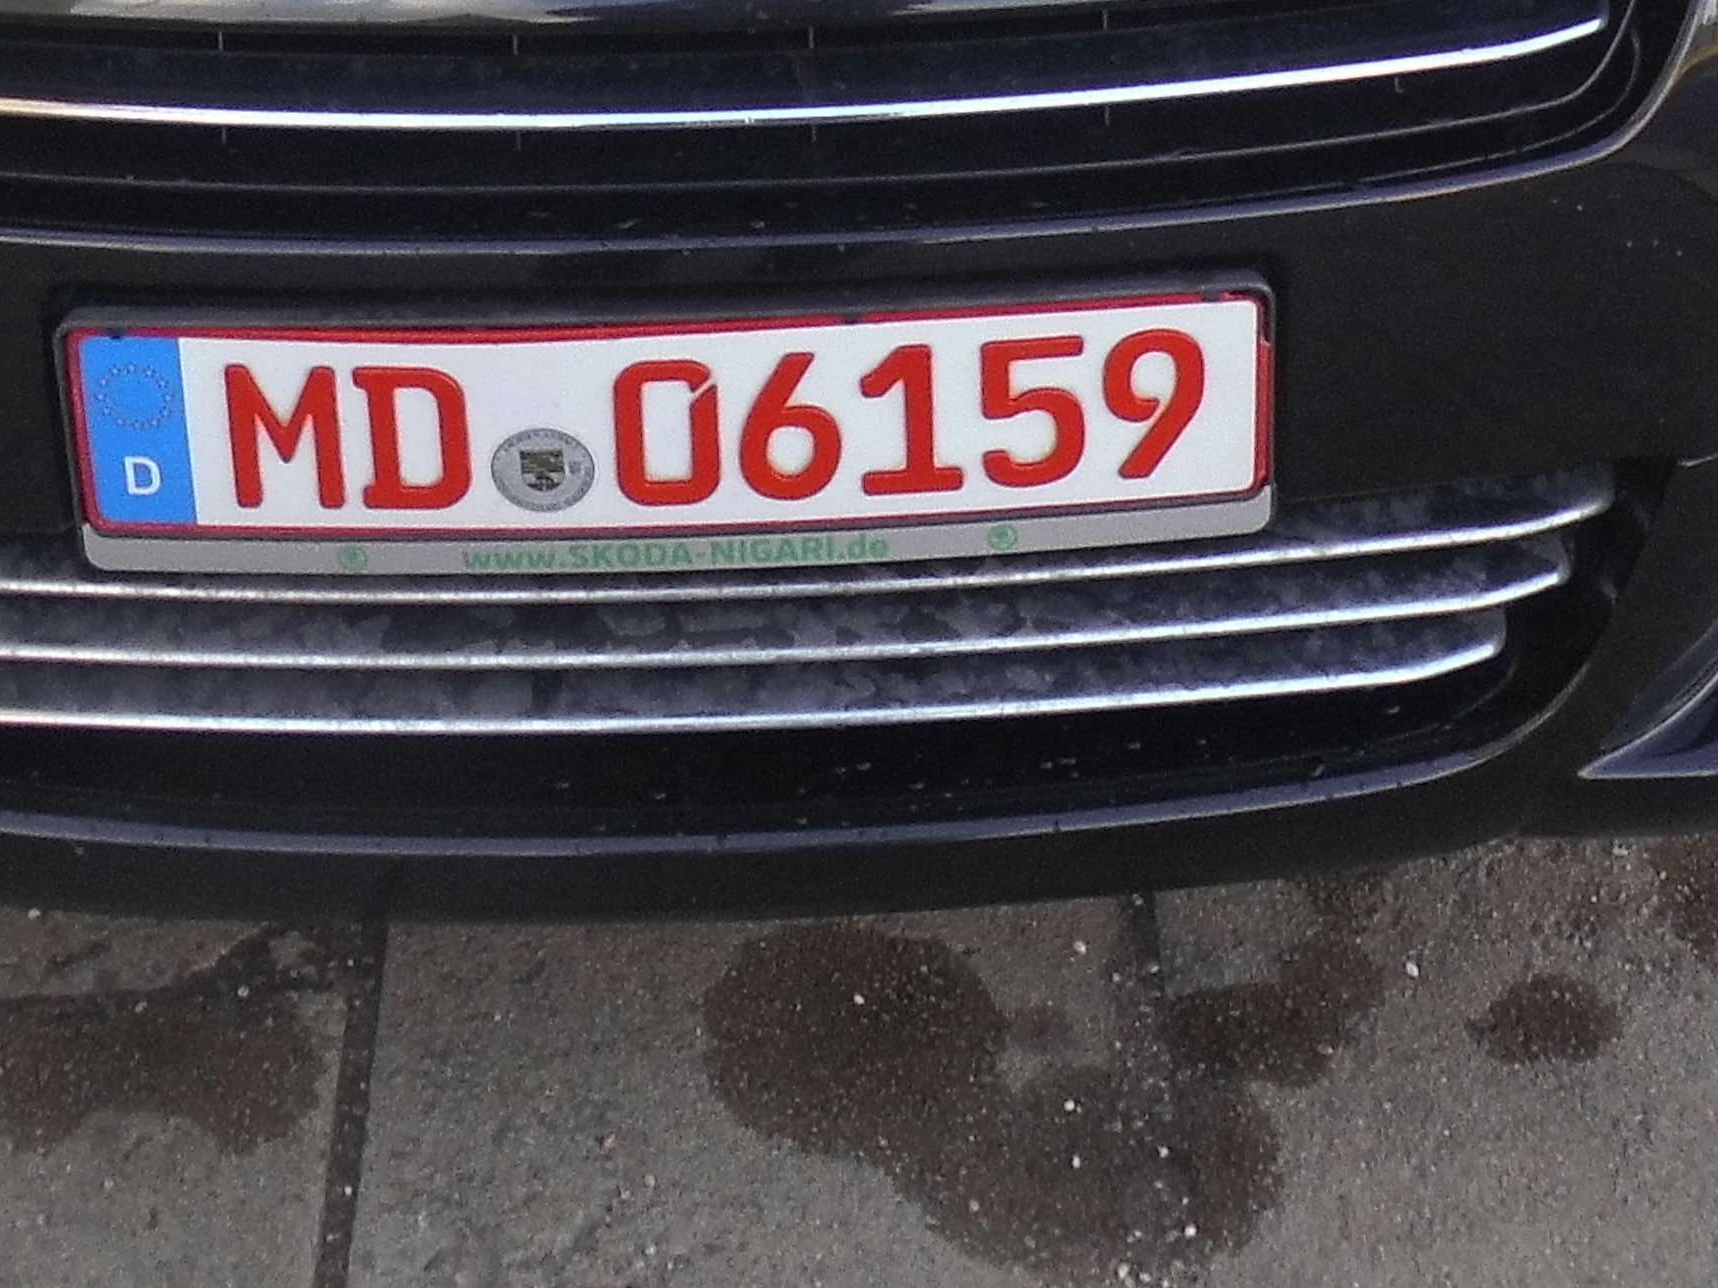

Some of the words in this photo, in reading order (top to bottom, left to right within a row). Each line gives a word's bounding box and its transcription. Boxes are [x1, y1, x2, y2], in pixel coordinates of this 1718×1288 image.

[125, 455, 161, 496] D
[224, 364, 472, 509] MD
[614, 327, 1205, 506] 06159
